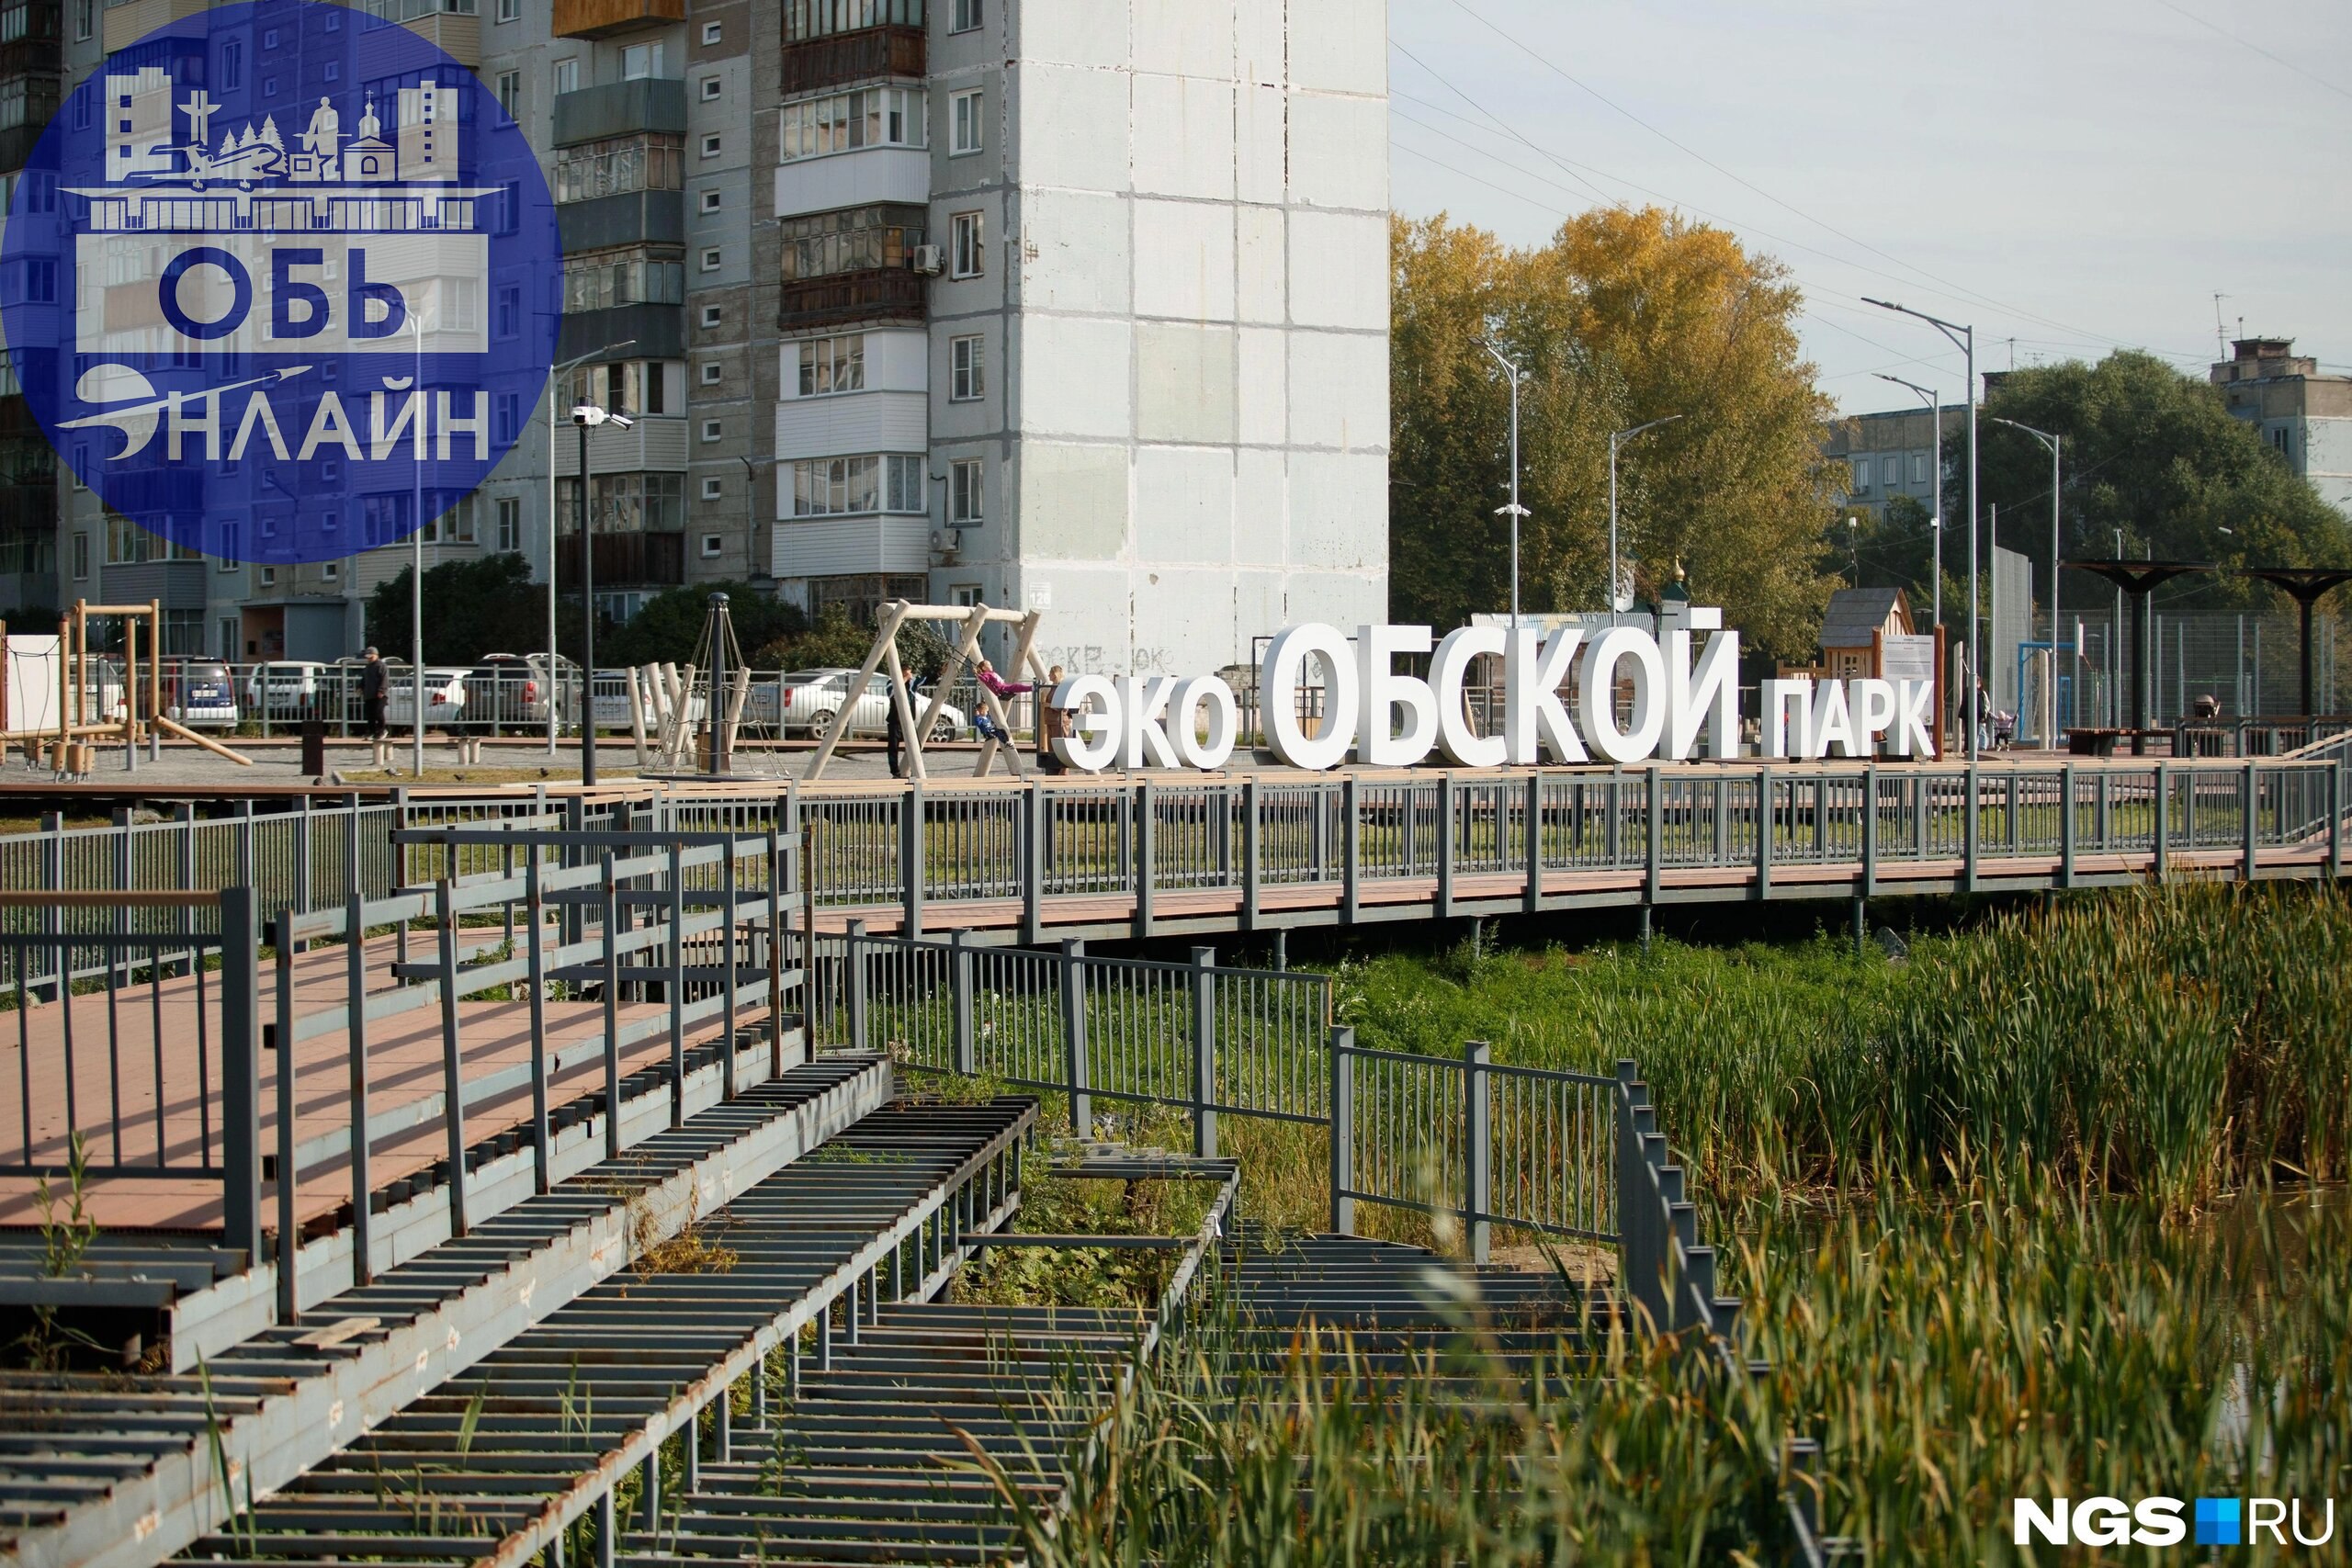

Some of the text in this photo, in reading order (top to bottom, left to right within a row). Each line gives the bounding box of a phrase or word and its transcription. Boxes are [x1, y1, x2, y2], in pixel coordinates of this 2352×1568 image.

[1051, 607, 1935, 771] ЭКО ОБСКОЙ ПАРК
